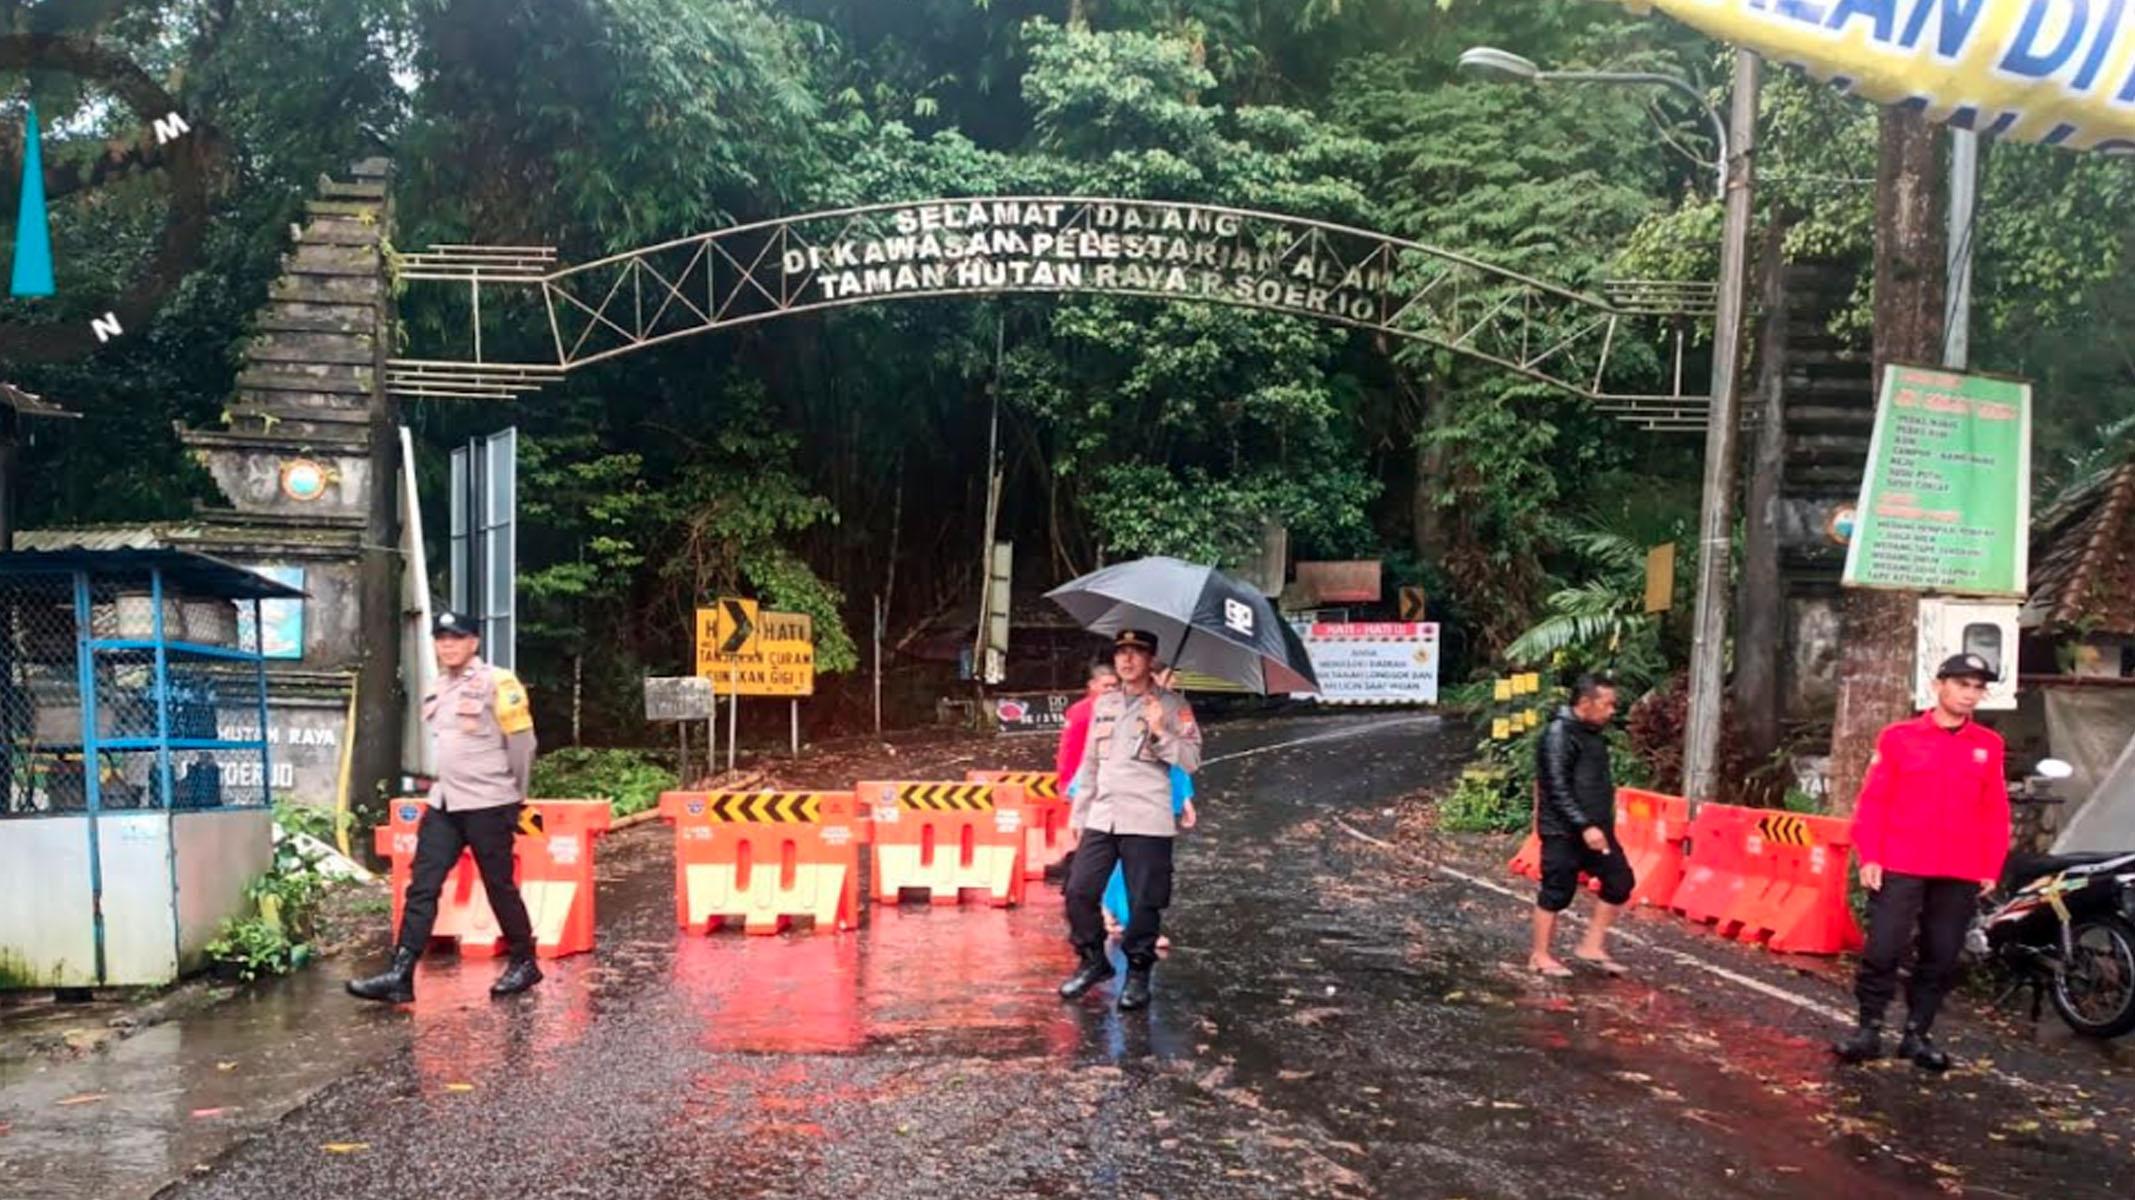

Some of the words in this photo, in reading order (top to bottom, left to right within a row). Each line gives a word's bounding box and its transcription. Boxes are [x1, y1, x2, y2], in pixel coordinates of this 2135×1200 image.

[897, 203, 1064, 233] SELAMAT
[783, 248, 820, 274] DI
[833, 231, 1029, 267] KAWASAN
[1032, 232, 1280, 272] PELESTARIAN
[817, 262, 945, 299] TAMAN
[957, 261, 1081, 287] HUTAN
[1095, 264, 1187, 291] RAYA
[288, 730, 335, 745] RAYA
